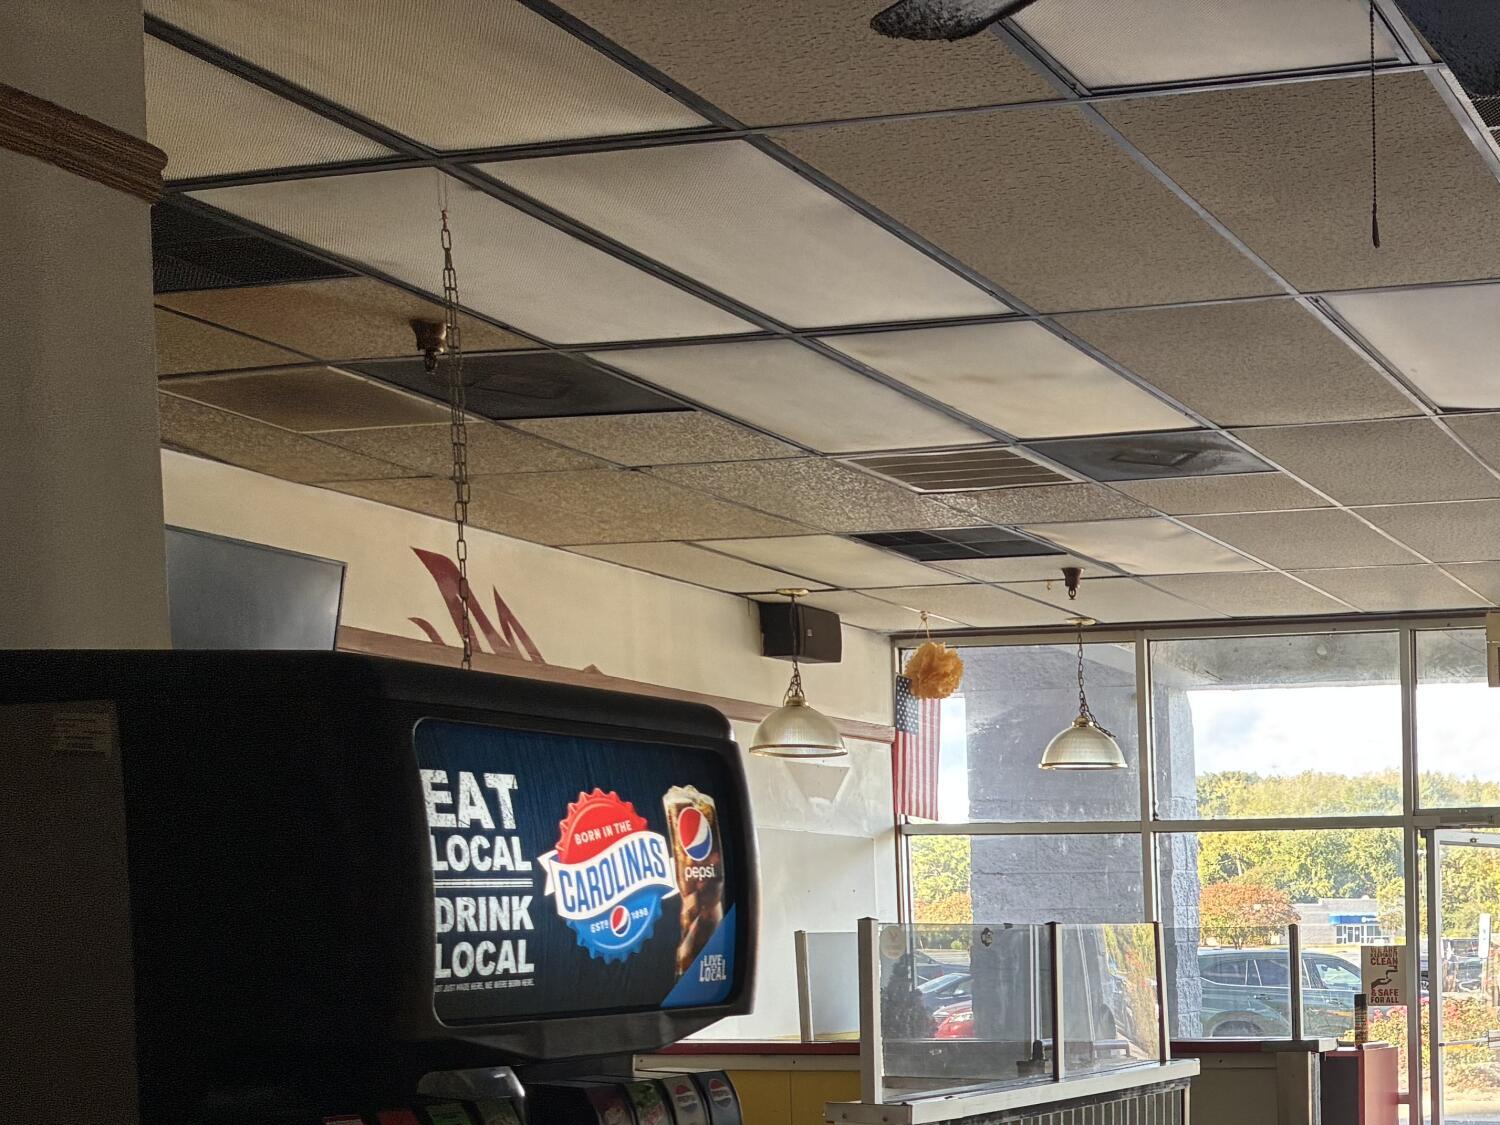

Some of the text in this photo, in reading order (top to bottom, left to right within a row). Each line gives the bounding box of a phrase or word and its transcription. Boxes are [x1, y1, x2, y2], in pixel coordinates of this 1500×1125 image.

[420, 769, 518, 829] EAT
[574, 820, 632, 845] BORN IN THE
[430, 834, 532, 871] LOCAL
[559, 837, 666, 913] CAROLINAS
[684, 864, 715, 880] pepsi
[434, 895, 535, 932] DRINK
[434, 939, 535, 978] LOCAL
[1370, 957, 1398, 966] CLEAN
